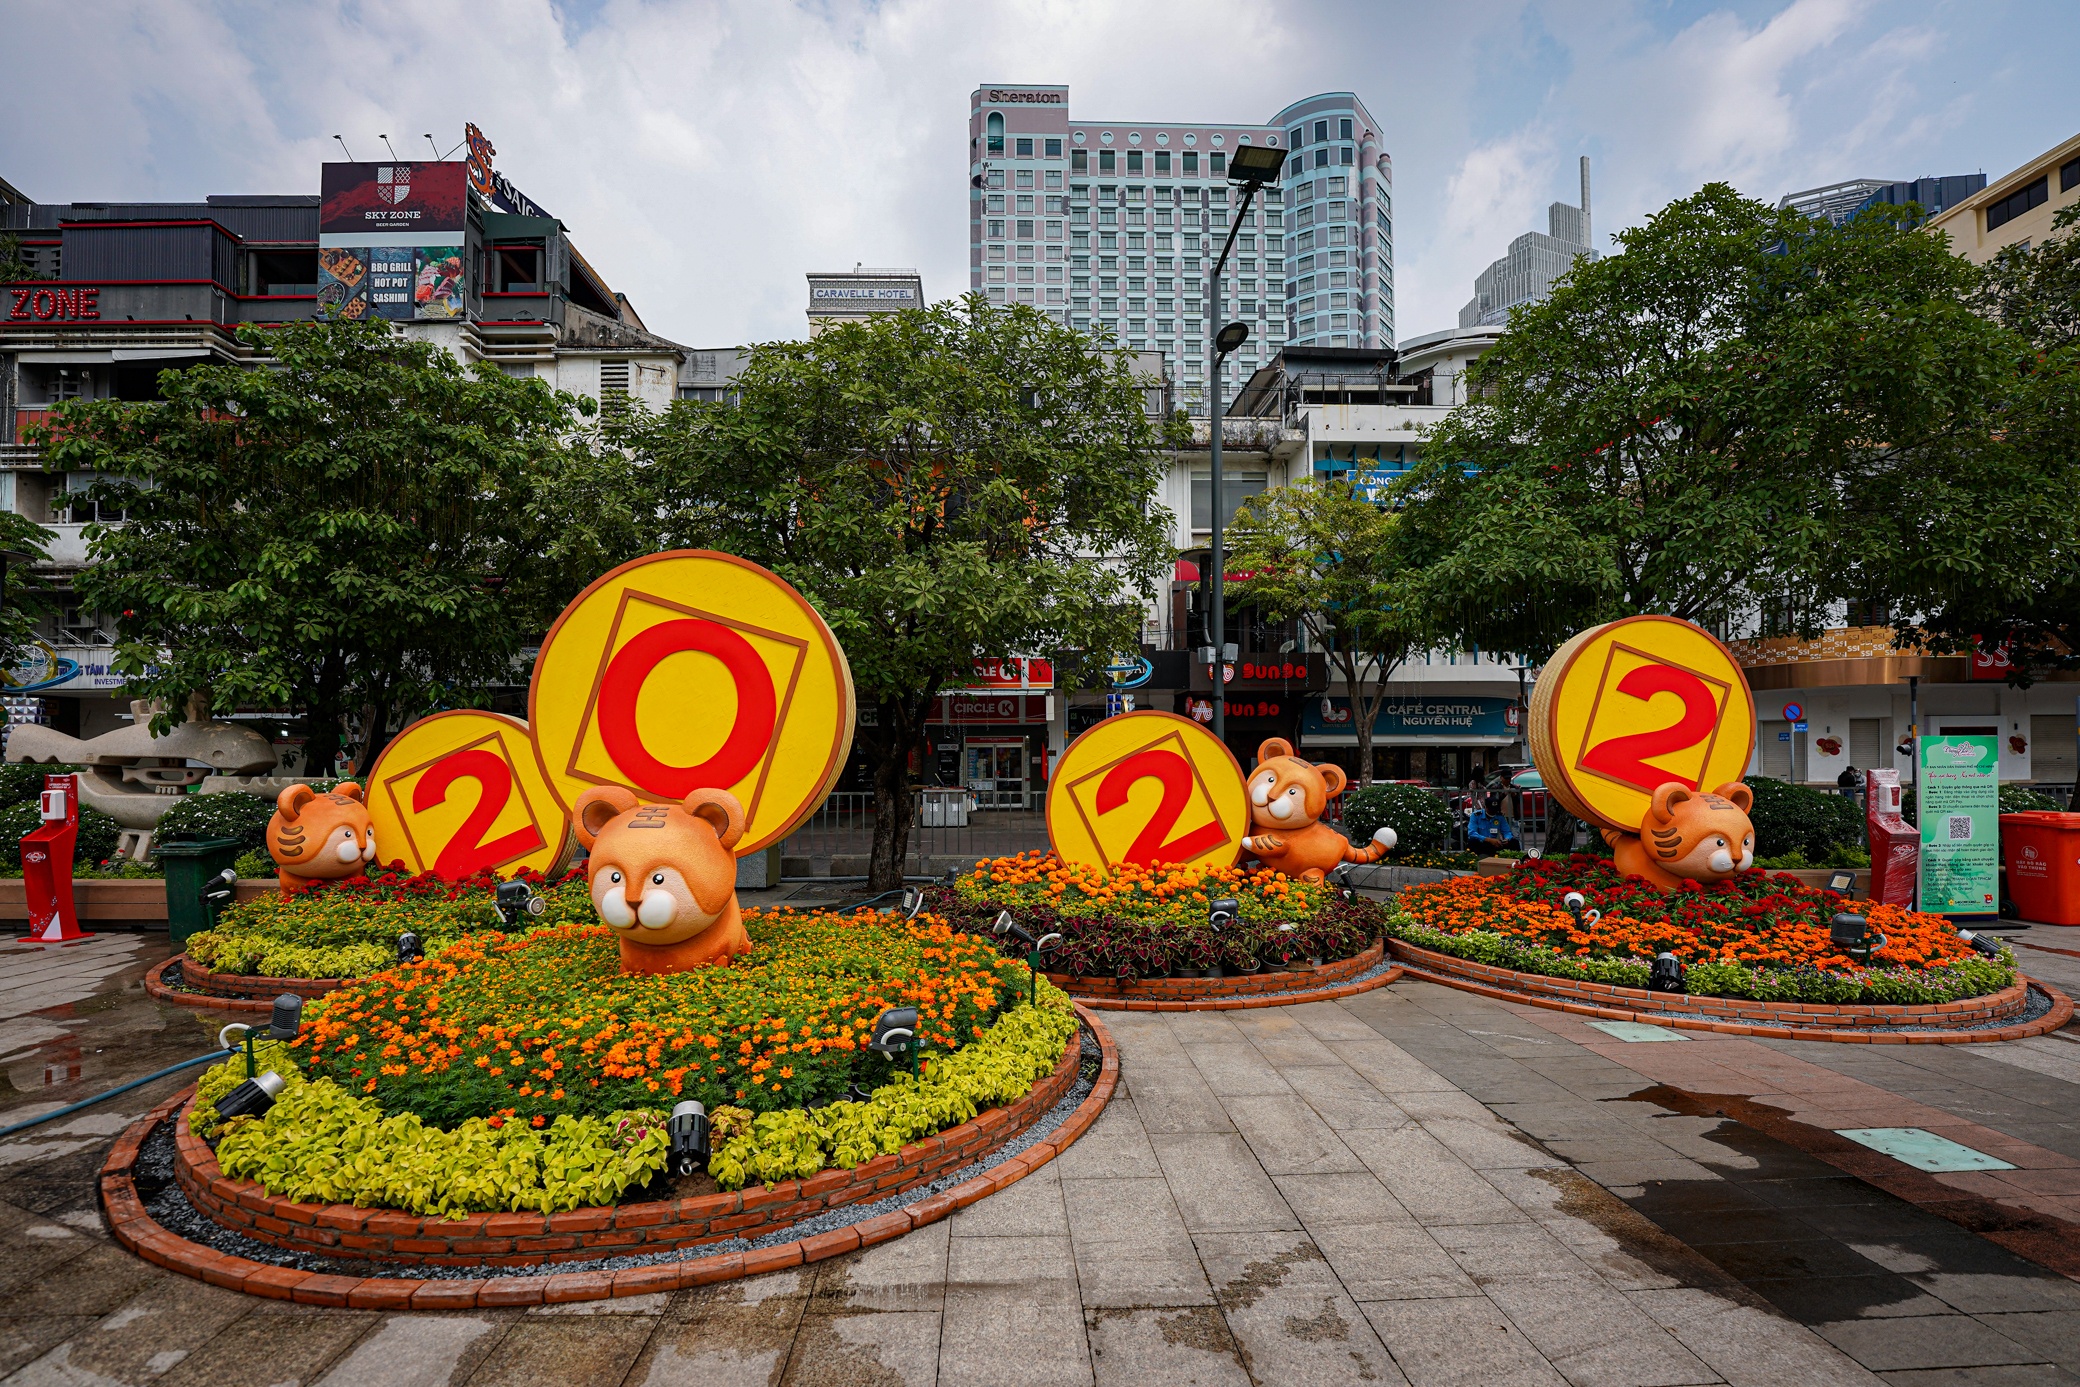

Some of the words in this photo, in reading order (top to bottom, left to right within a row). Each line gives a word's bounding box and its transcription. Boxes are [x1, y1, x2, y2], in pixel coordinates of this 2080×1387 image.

[988, 89, 1061, 104] Sheraton
[365, 212, 388, 220] SKY
[390, 211, 421, 220] ZONE
[371, 263, 388, 272] BBQ
[390, 262, 412, 272] GRILL
[374, 278, 389, 288] HOT
[392, 278, 408, 288] POT
[373, 293, 408, 303] SASHIMI
[816, 289, 875, 298] CARAVELLE
[878, 288, 912, 298] HOTEL
[10, 288, 100, 319] ZONE
[954, 703, 996, 713] CIRCLE
[1426, 705, 1486, 715] CENTRAL
[1581, 665, 1717, 792] 2
[413, 750, 541, 880] 2
[1096, 750, 1226, 874] 2
